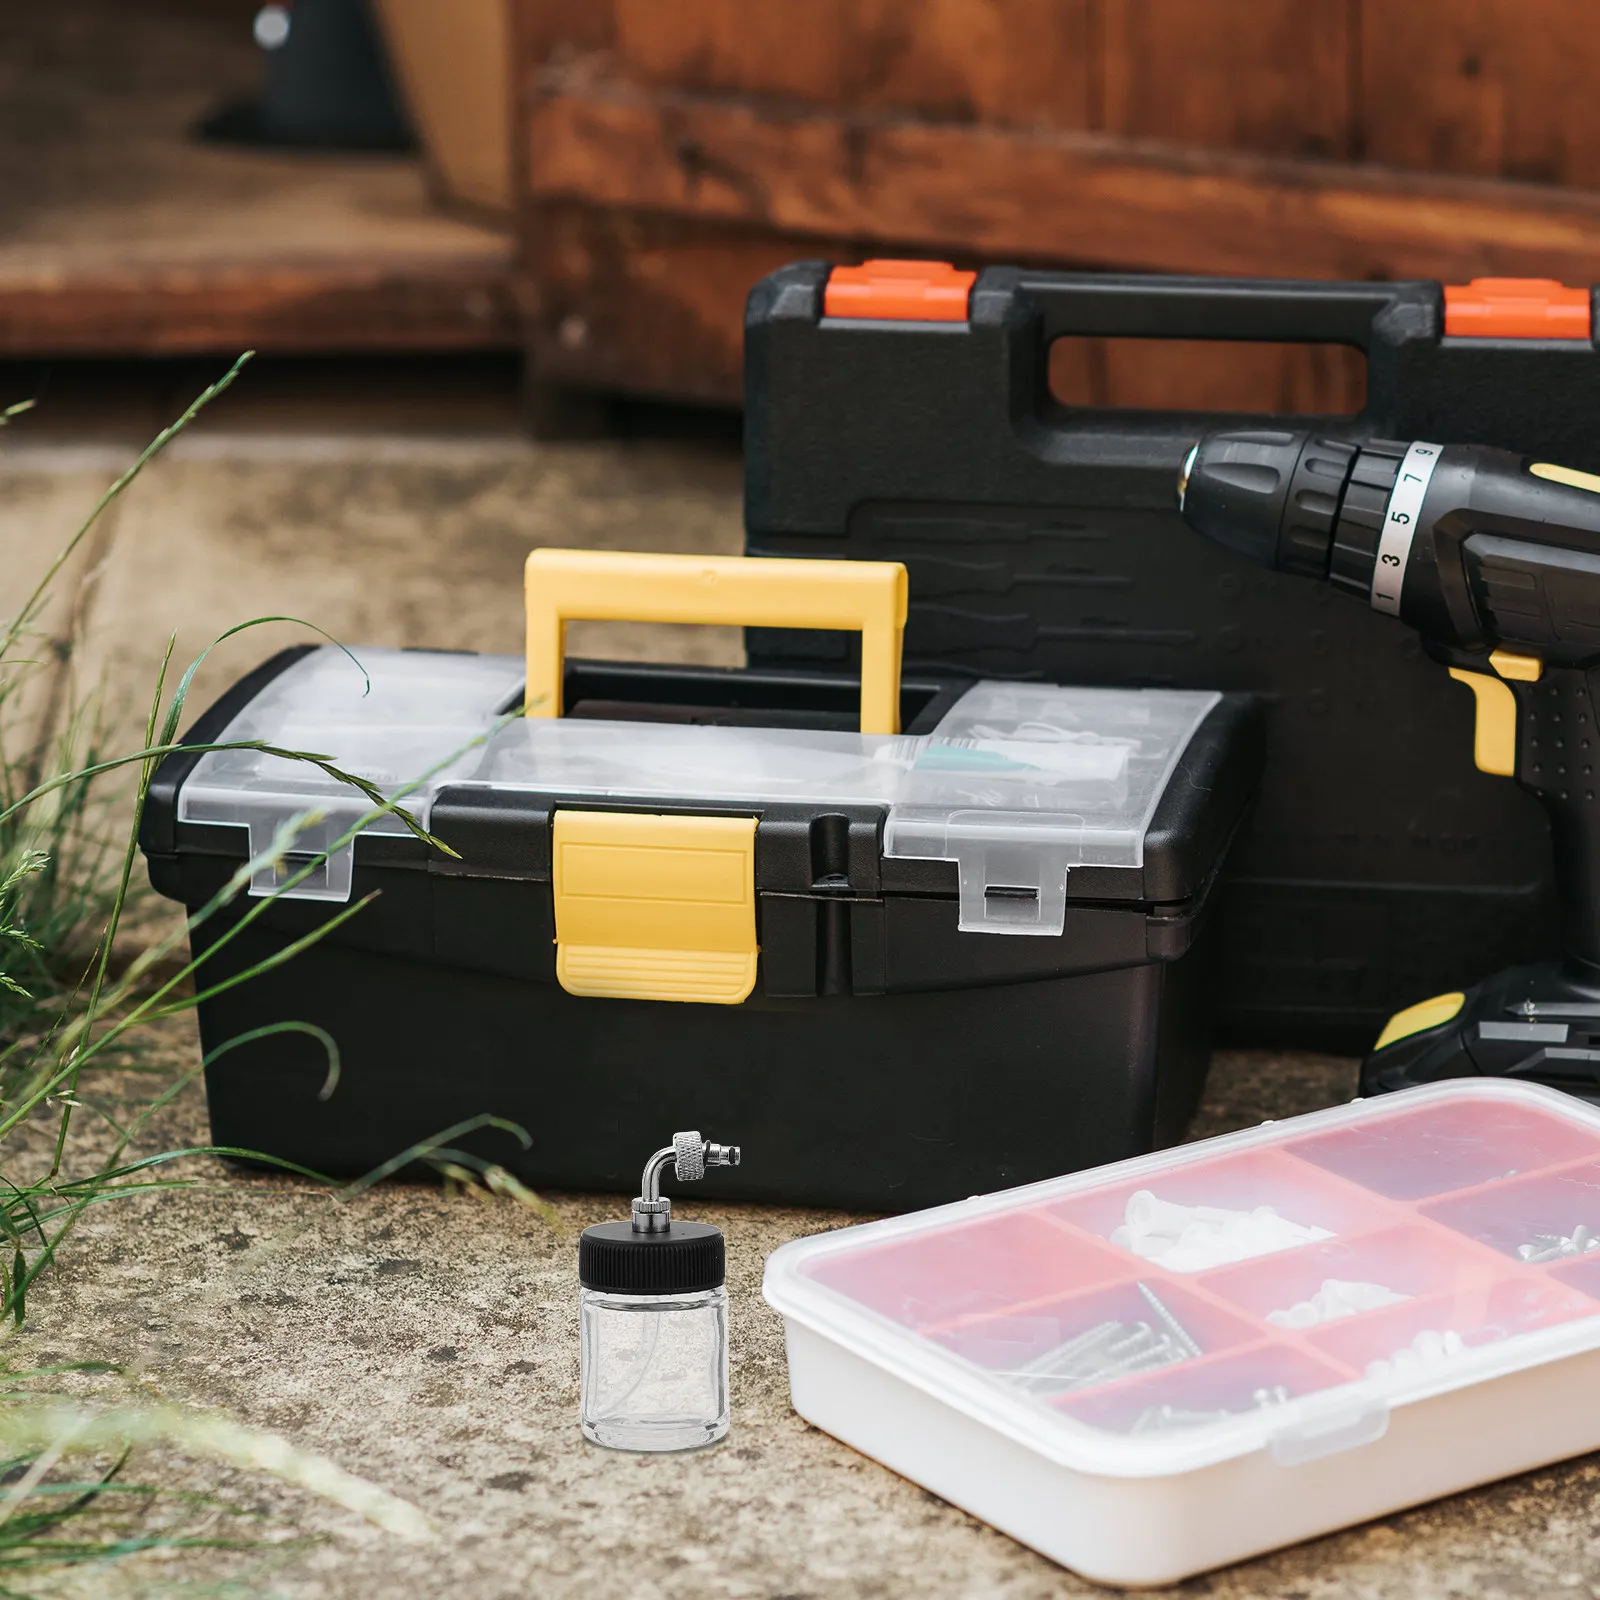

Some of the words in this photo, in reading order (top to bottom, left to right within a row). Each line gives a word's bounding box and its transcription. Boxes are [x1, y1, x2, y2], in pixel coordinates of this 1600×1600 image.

[1415, 448, 1434, 456] 9
[1403, 473, 1423, 483] 7
[1391, 511, 1410, 525] 5
[1381, 553, 1401, 567] 3
[1376, 592, 1395, 600] 1
